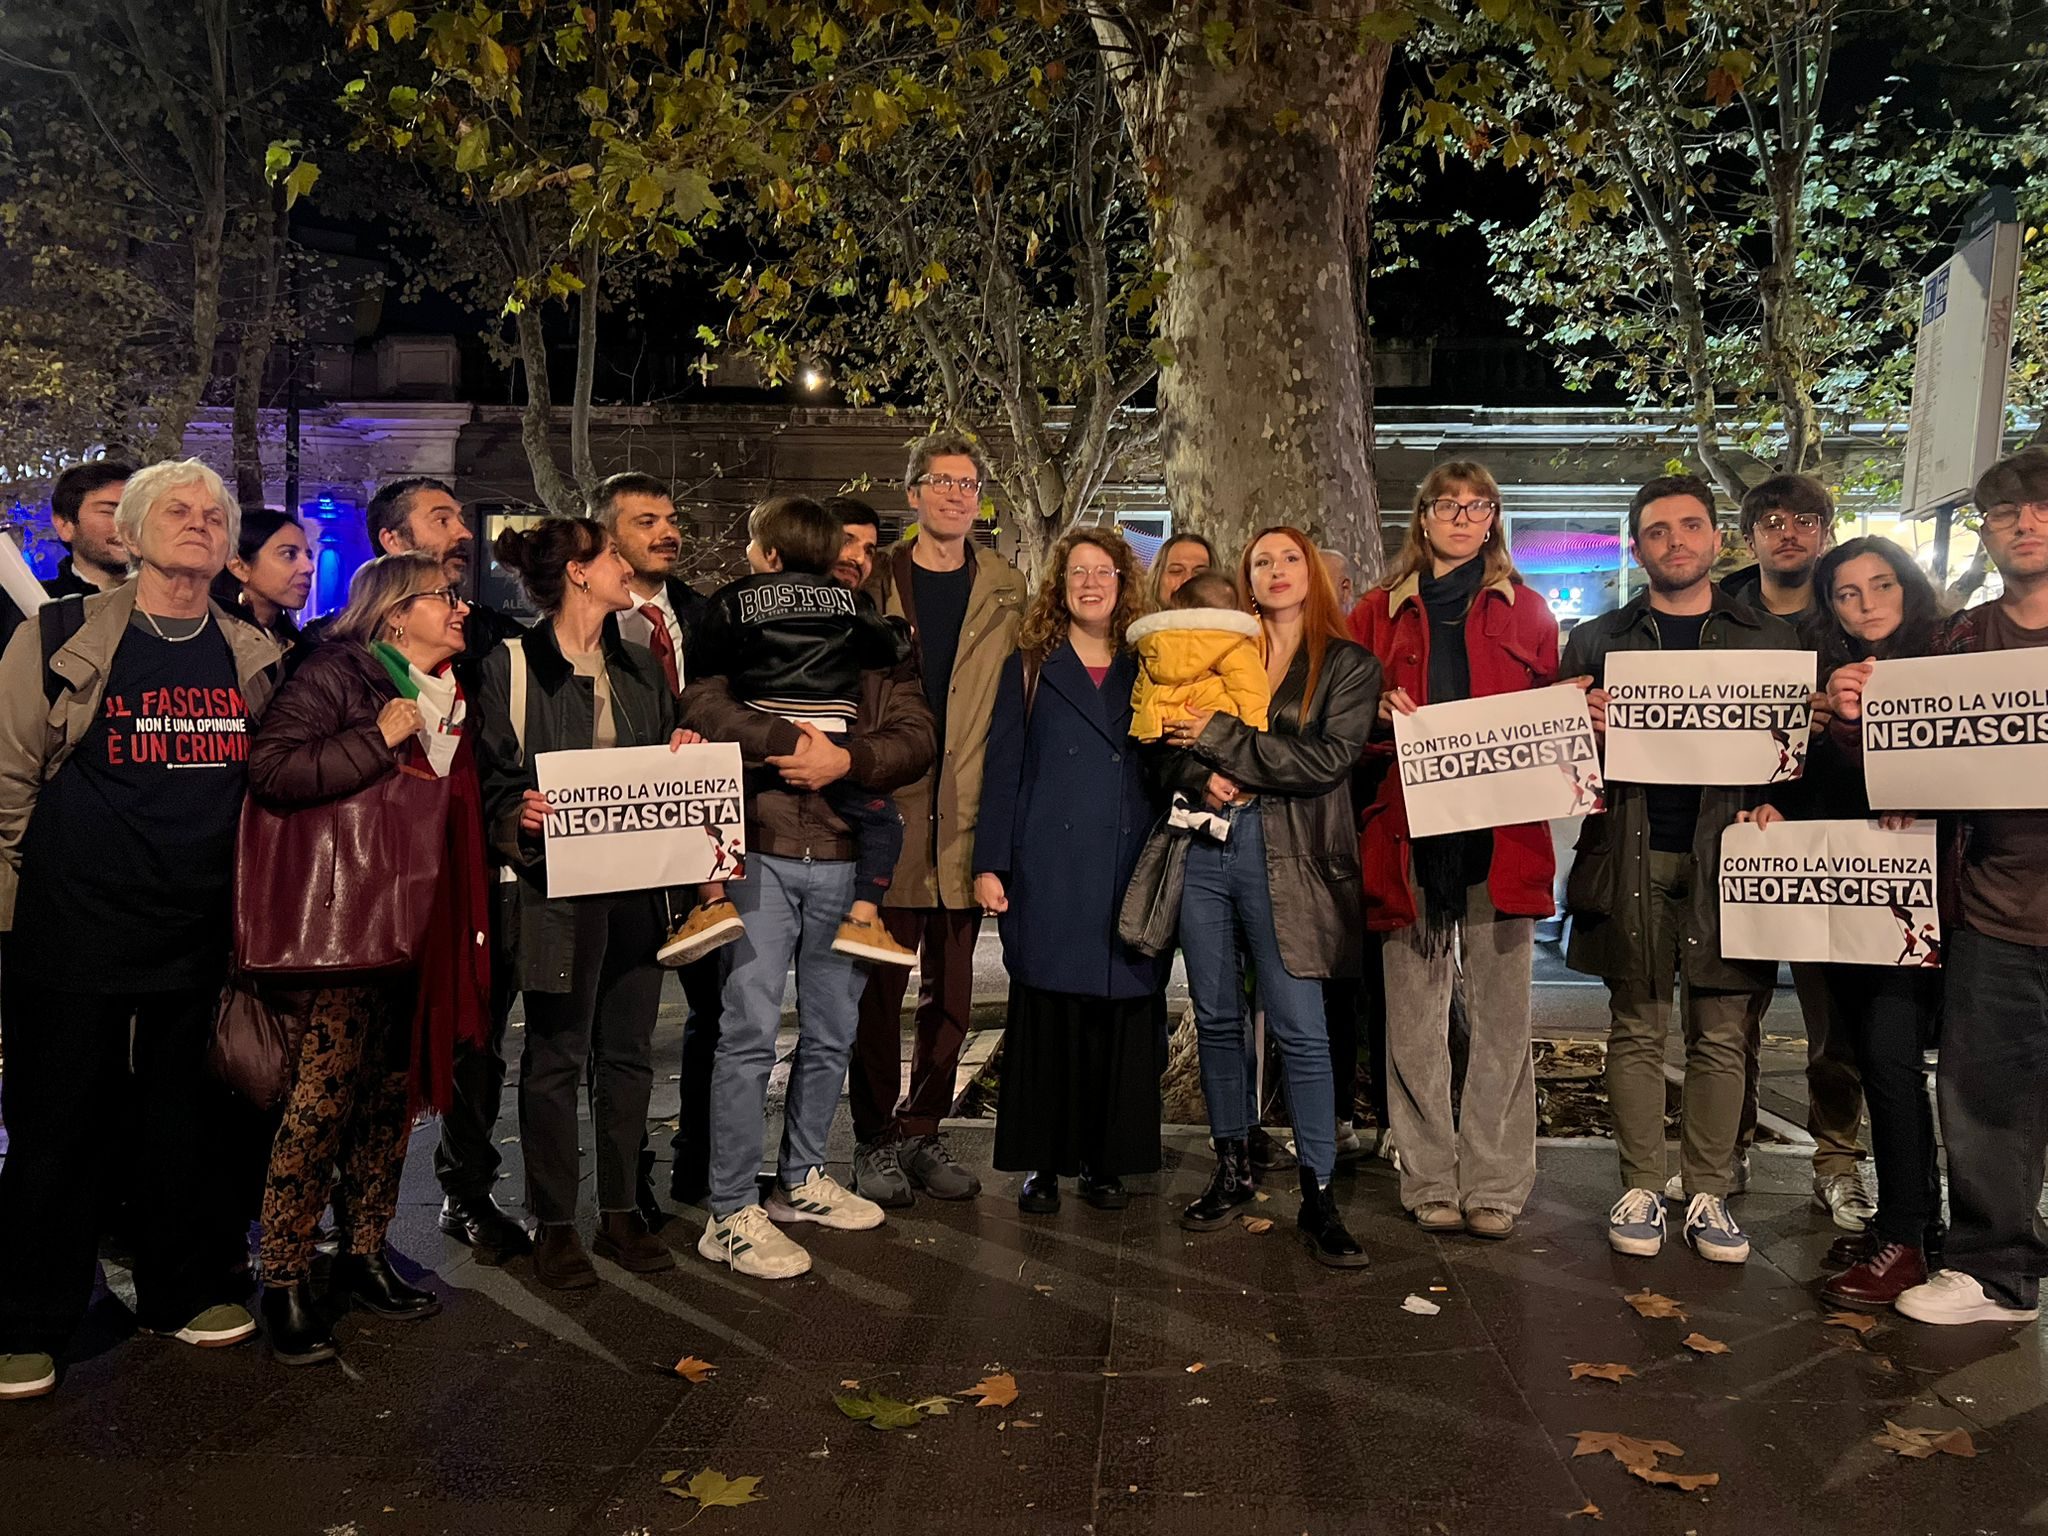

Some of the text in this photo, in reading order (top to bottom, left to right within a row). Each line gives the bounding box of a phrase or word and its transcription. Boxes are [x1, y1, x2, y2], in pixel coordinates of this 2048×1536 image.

[738, 584, 856, 623] BOSTON
[1608, 684, 1811, 700] CONTRO LA VIOLENZA
[1867, 689, 2048, 717] CONTRO LA VIOL
[105, 696, 132, 718] IL
[1608, 704, 1807, 729] NEOFASCISTA
[136, 715, 247, 733] NON È UNA OPINIONE
[1401, 716, 1589, 757] CONTRO LA VIOLENZA
[107, 728, 124, 764] È
[130, 733, 168, 764] UN
[1404, 735, 1593, 785] NEOFASCISTA
[546, 778, 739, 805] CONTRO LA VIOLENZA
[548, 799, 739, 837] NEOFASCISTA
[1723, 857, 1932, 874] CONTRO LA VIOLENZA
[1723, 877, 1931, 906] NEOFASCISTA
